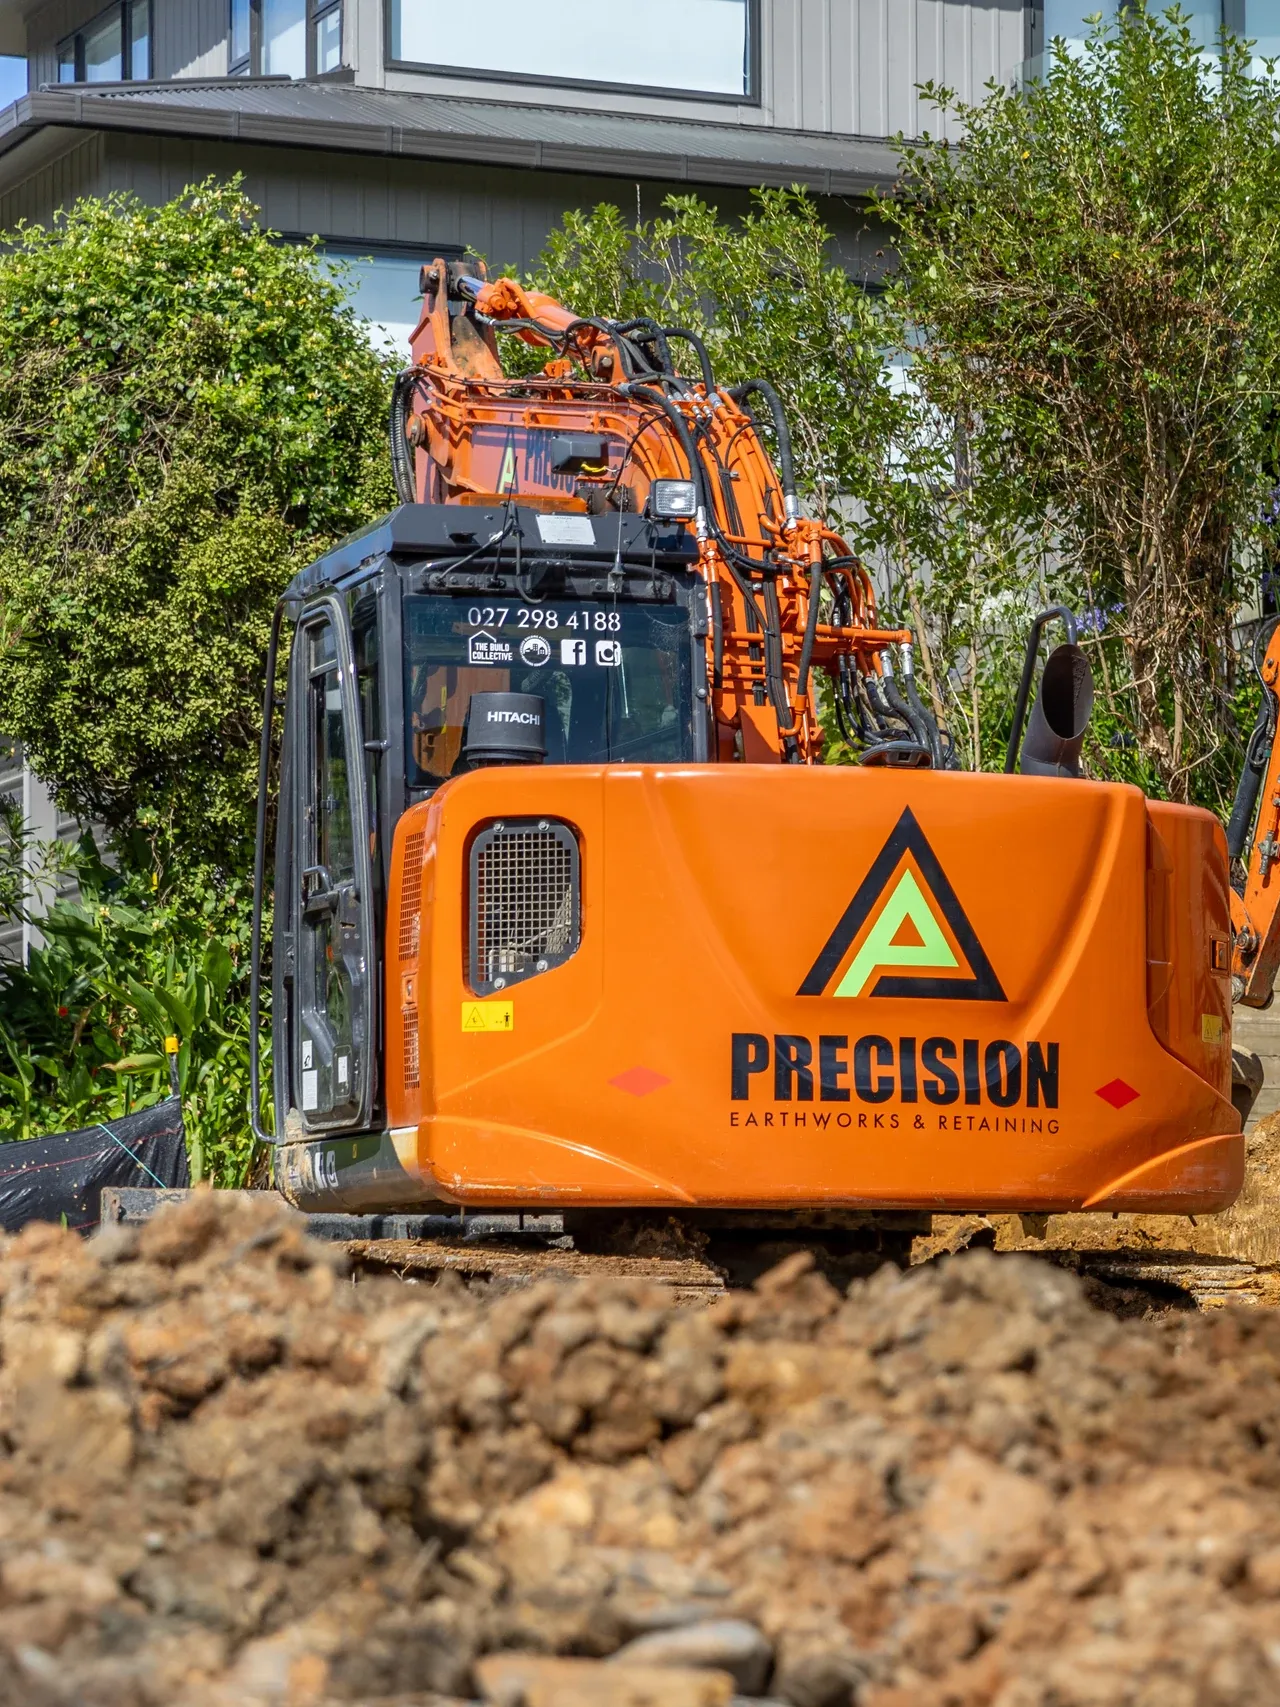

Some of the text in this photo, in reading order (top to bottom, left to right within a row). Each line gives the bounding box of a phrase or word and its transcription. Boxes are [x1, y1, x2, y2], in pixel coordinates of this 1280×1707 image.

[467, 606, 622, 632] 027 298 4188
[472, 651, 513, 661] COLLECTIVE
[475, 642, 510, 652] THE BUILD
[487, 710, 540, 726] HITACHI
[730, 1032, 1060, 1110] PRECISION
[730, 1111, 1060, 1135] EARTHWORKS & RETAINING
